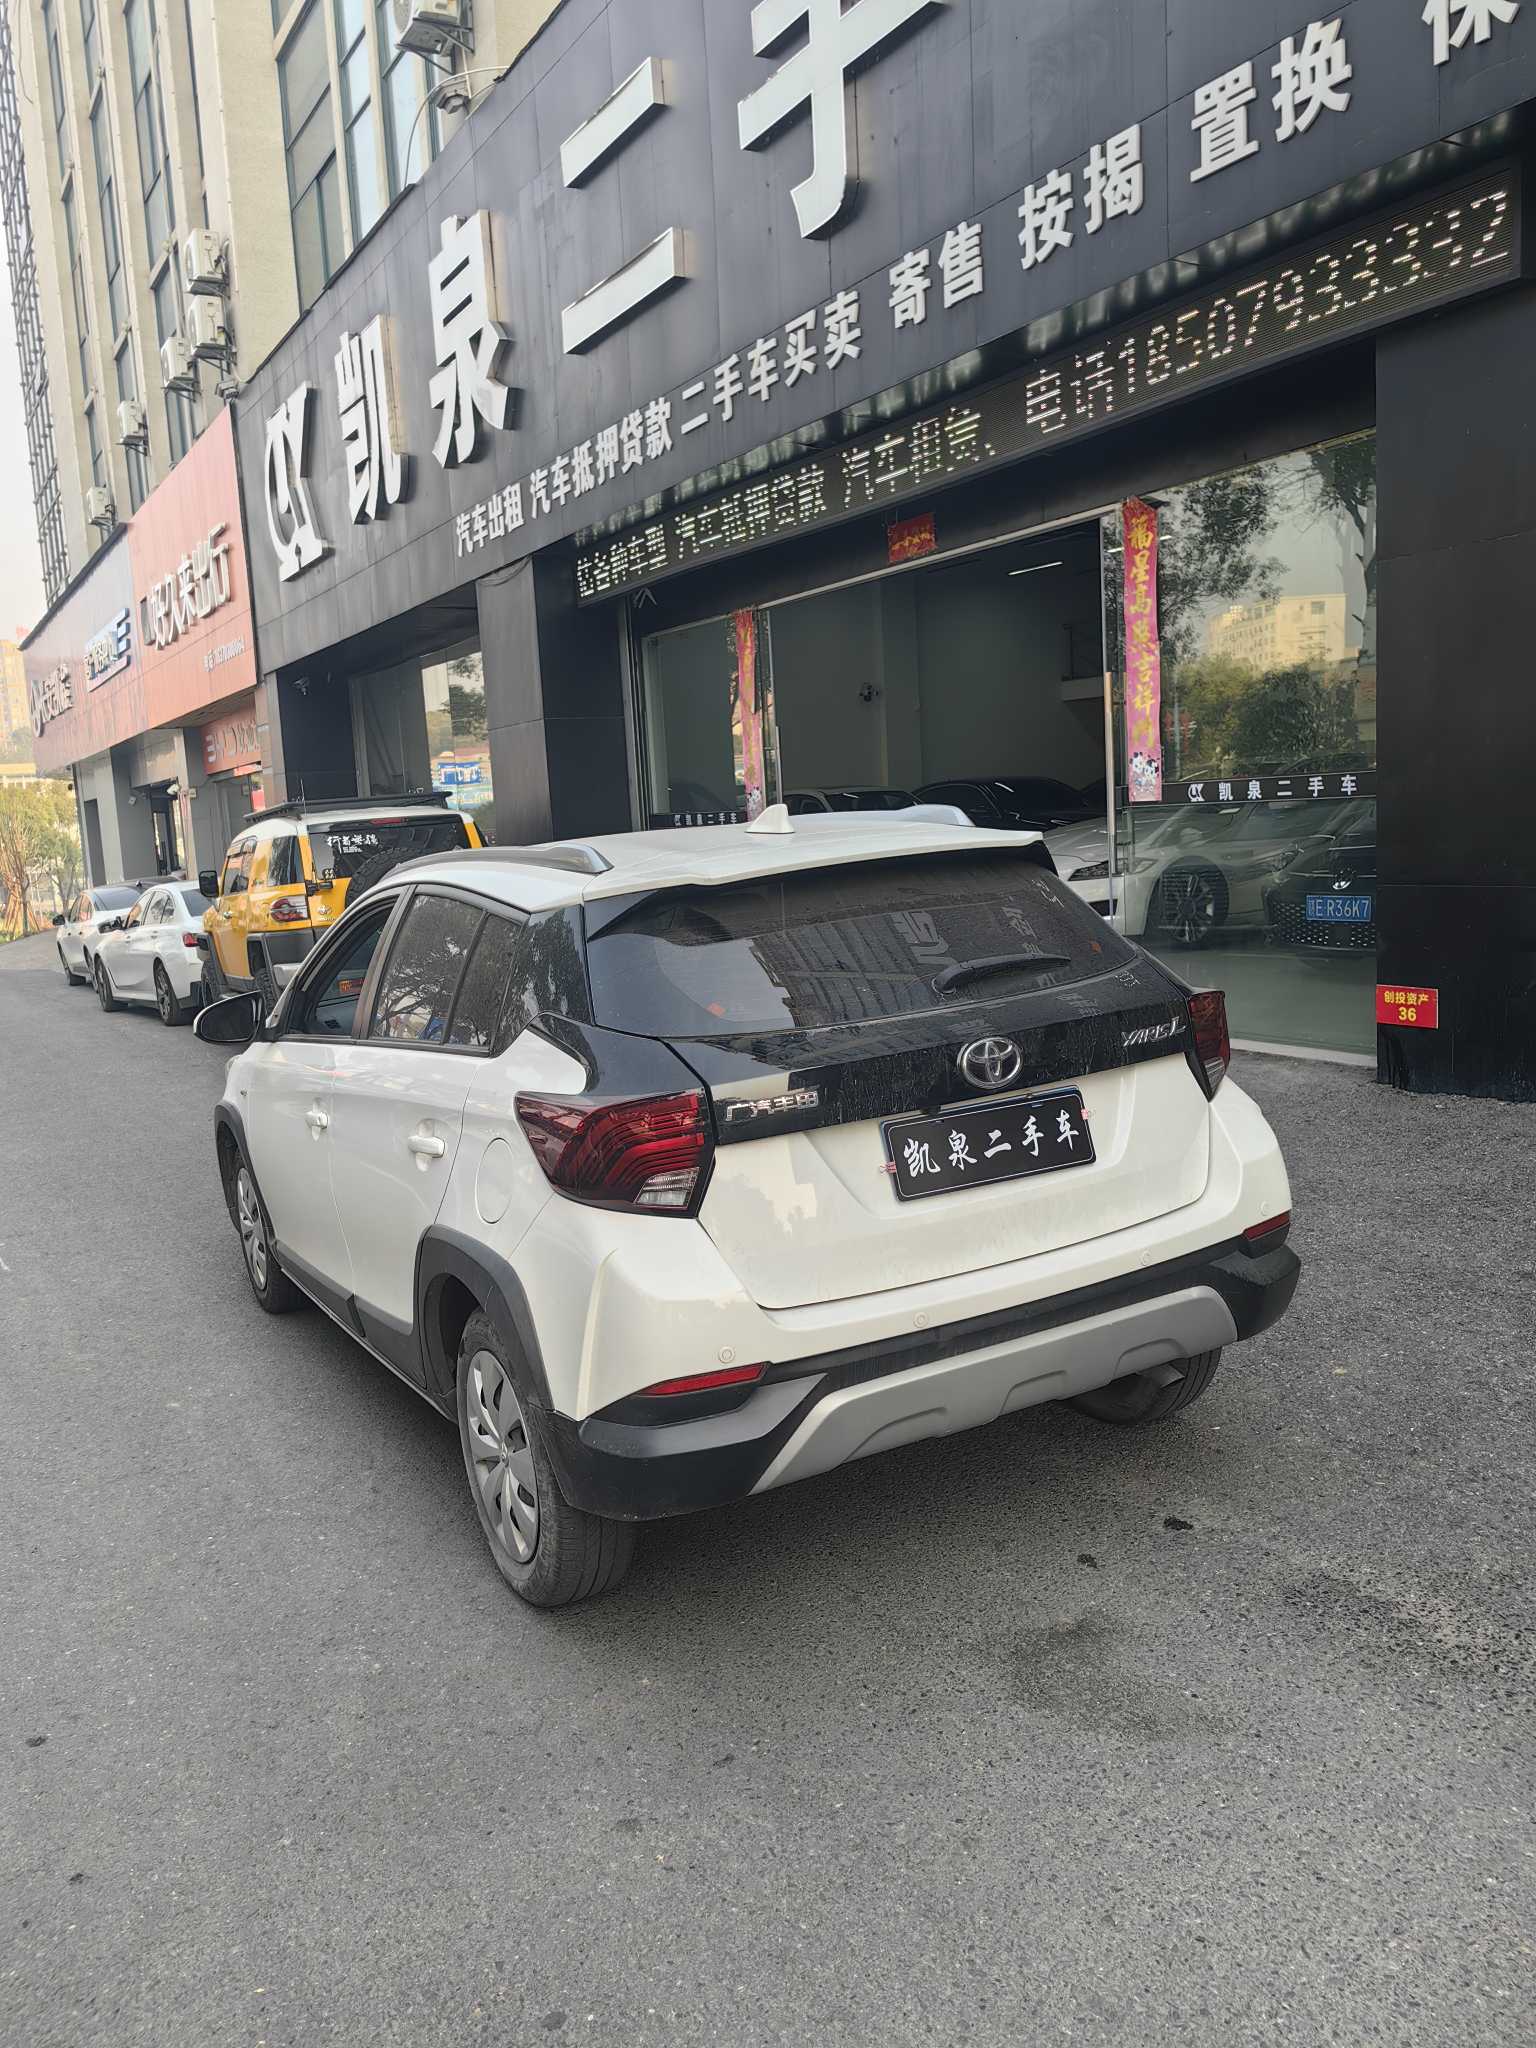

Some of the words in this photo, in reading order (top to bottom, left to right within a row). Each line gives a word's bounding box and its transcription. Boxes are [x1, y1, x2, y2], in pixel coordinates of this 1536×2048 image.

[456, 482, 525, 557] 汽车出租
[530, 397, 673, 519] 汽车抵押贷款
[681, 290, 862, 434] 二手车买卖
[889, 221, 984, 328] 寄售
[1018, 124, 1144, 269] 按揭
[1190, 17, 1352, 182] 置换
[1219, 775, 1357, 801] 凯泉二手车
[1384, 990, 1429, 1006] 创投资产
[1399, 1006, 1417, 1022] 36
[725, 1090, 819, 1122] 广汽丰田
[903, 1108, 1080, 1178] 凯泉二手车
